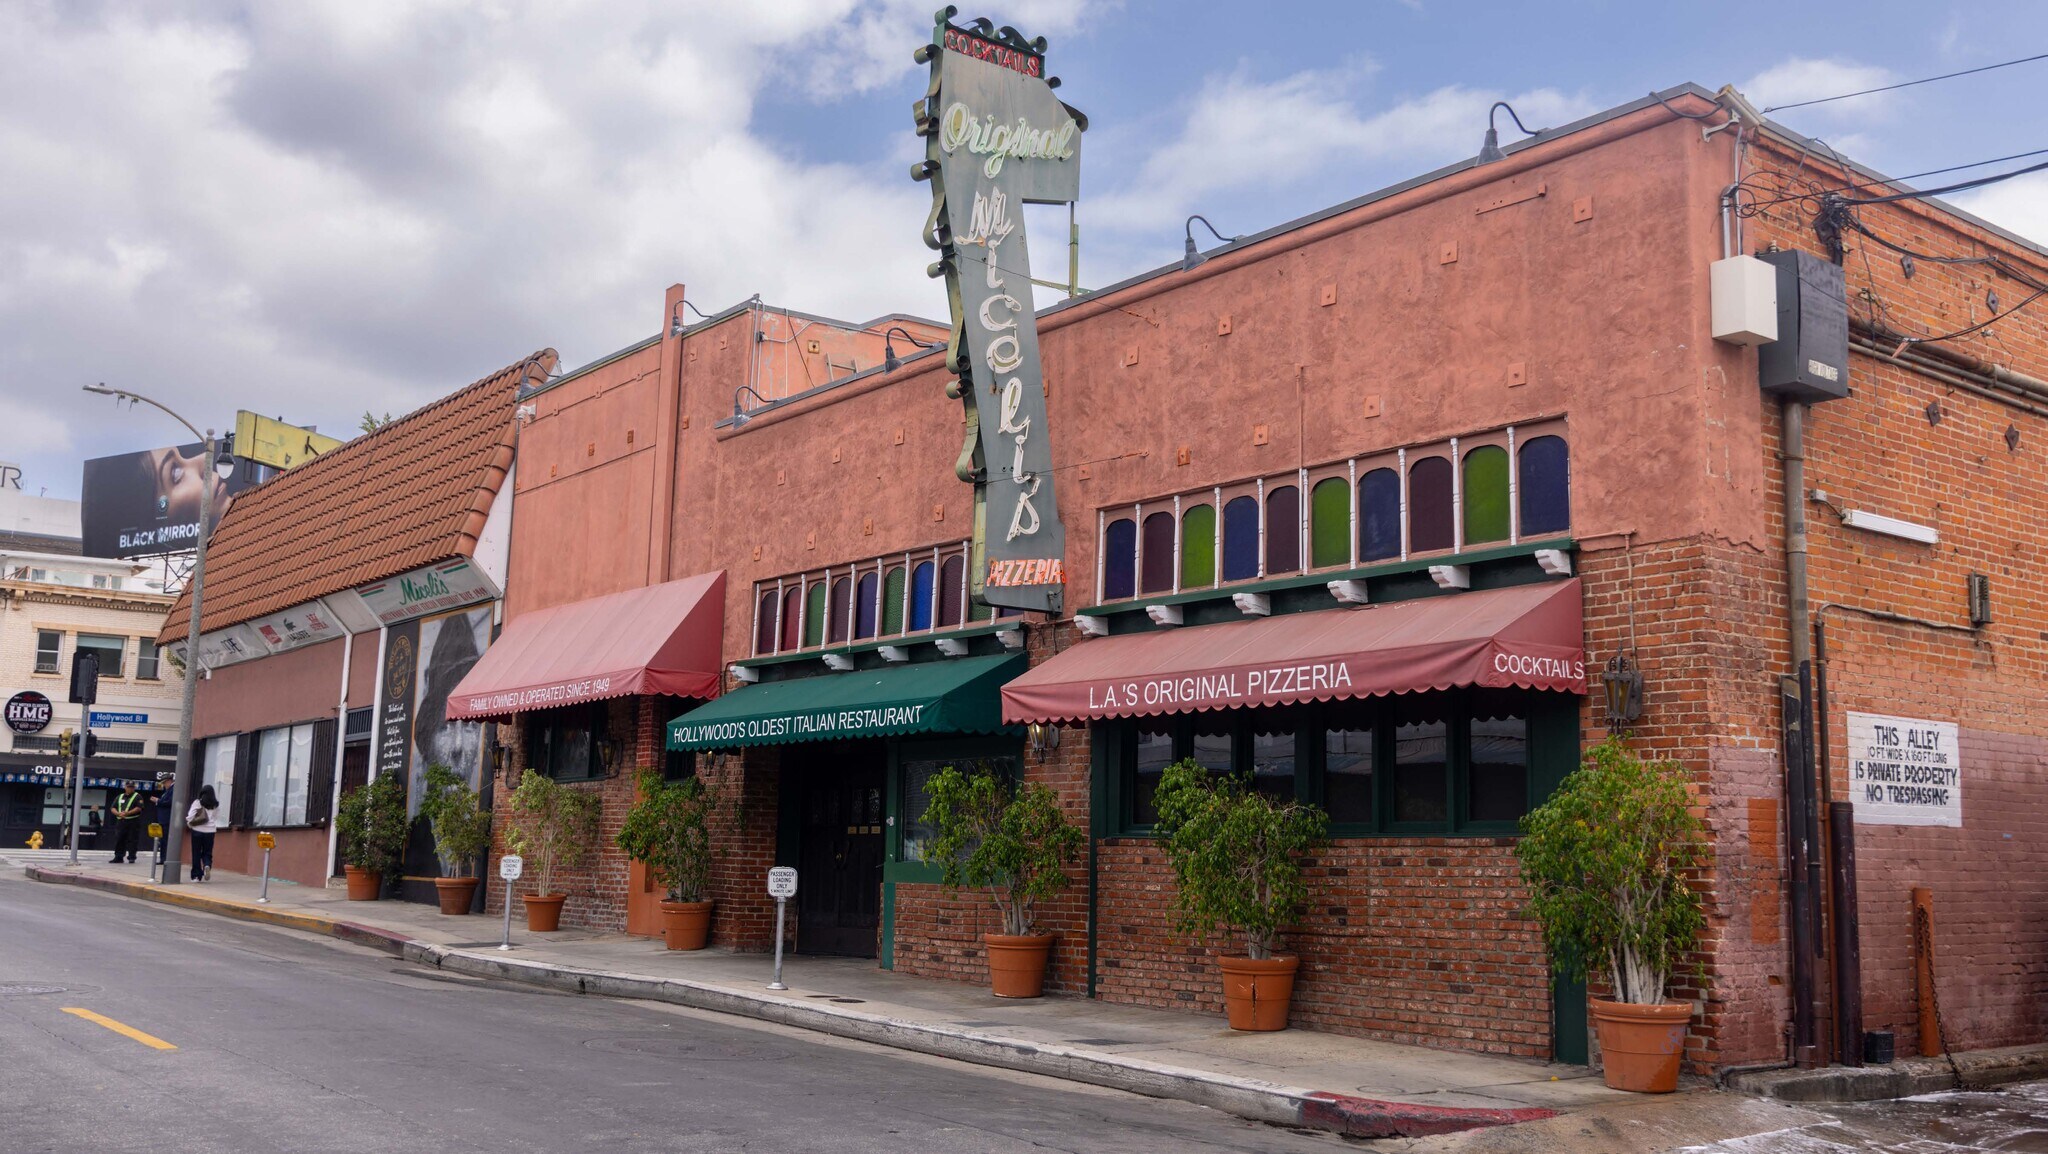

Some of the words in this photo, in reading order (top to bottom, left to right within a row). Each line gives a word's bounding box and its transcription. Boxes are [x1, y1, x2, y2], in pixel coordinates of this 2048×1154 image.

[945, 29, 1040, 77] COCKTAILS
[940, 102, 1076, 179] Original
[0, 466, 21, 489] R
[119, 531, 156, 548] BLACK
[986, 558, 1066, 587] PIZZERIA
[399, 572, 449, 605] Miceli's
[1494, 653, 1584, 679] COCKTAILS
[470, 696, 493, 711] FAMILY
[493, 692, 518, 708] OWNED
[520, 692, 525, 704] &
[526, 686, 564, 703] OPERATED
[567, 681, 590, 698] SINCE
[592, 678, 610, 693] 1949
[1089, 683, 1138, 709] L.A.'S
[1144, 673, 1241, 704] ORIGINAL
[1248, 662, 1352, 695] PIZZERIA
[9, 705, 49, 720] HMC
[97, 713, 133, 722] Hollywood
[674, 721, 745, 743] HOLLYWOOD'S
[748, 717, 791, 737] OLDEST
[793, 713, 836, 733] ITALIAN
[838, 705, 924, 729] RESTAURANT
[1874, 725, 1899, 746] THIS
[1907, 729, 1940, 751] ALLEY
[1887, 747, 1903, 760] WIDE
[1933, 752, 1947, 764] LONG
[35, 765, 63, 775] COLD
[1855, 761, 1864, 779] IS
[1867, 762, 1901, 782] PRIVATE
[1904, 764, 1957, 786] PROPERTY
[1866, 784, 1883, 802] NO
[1887, 785, 1949, 806] TRESPASSING
